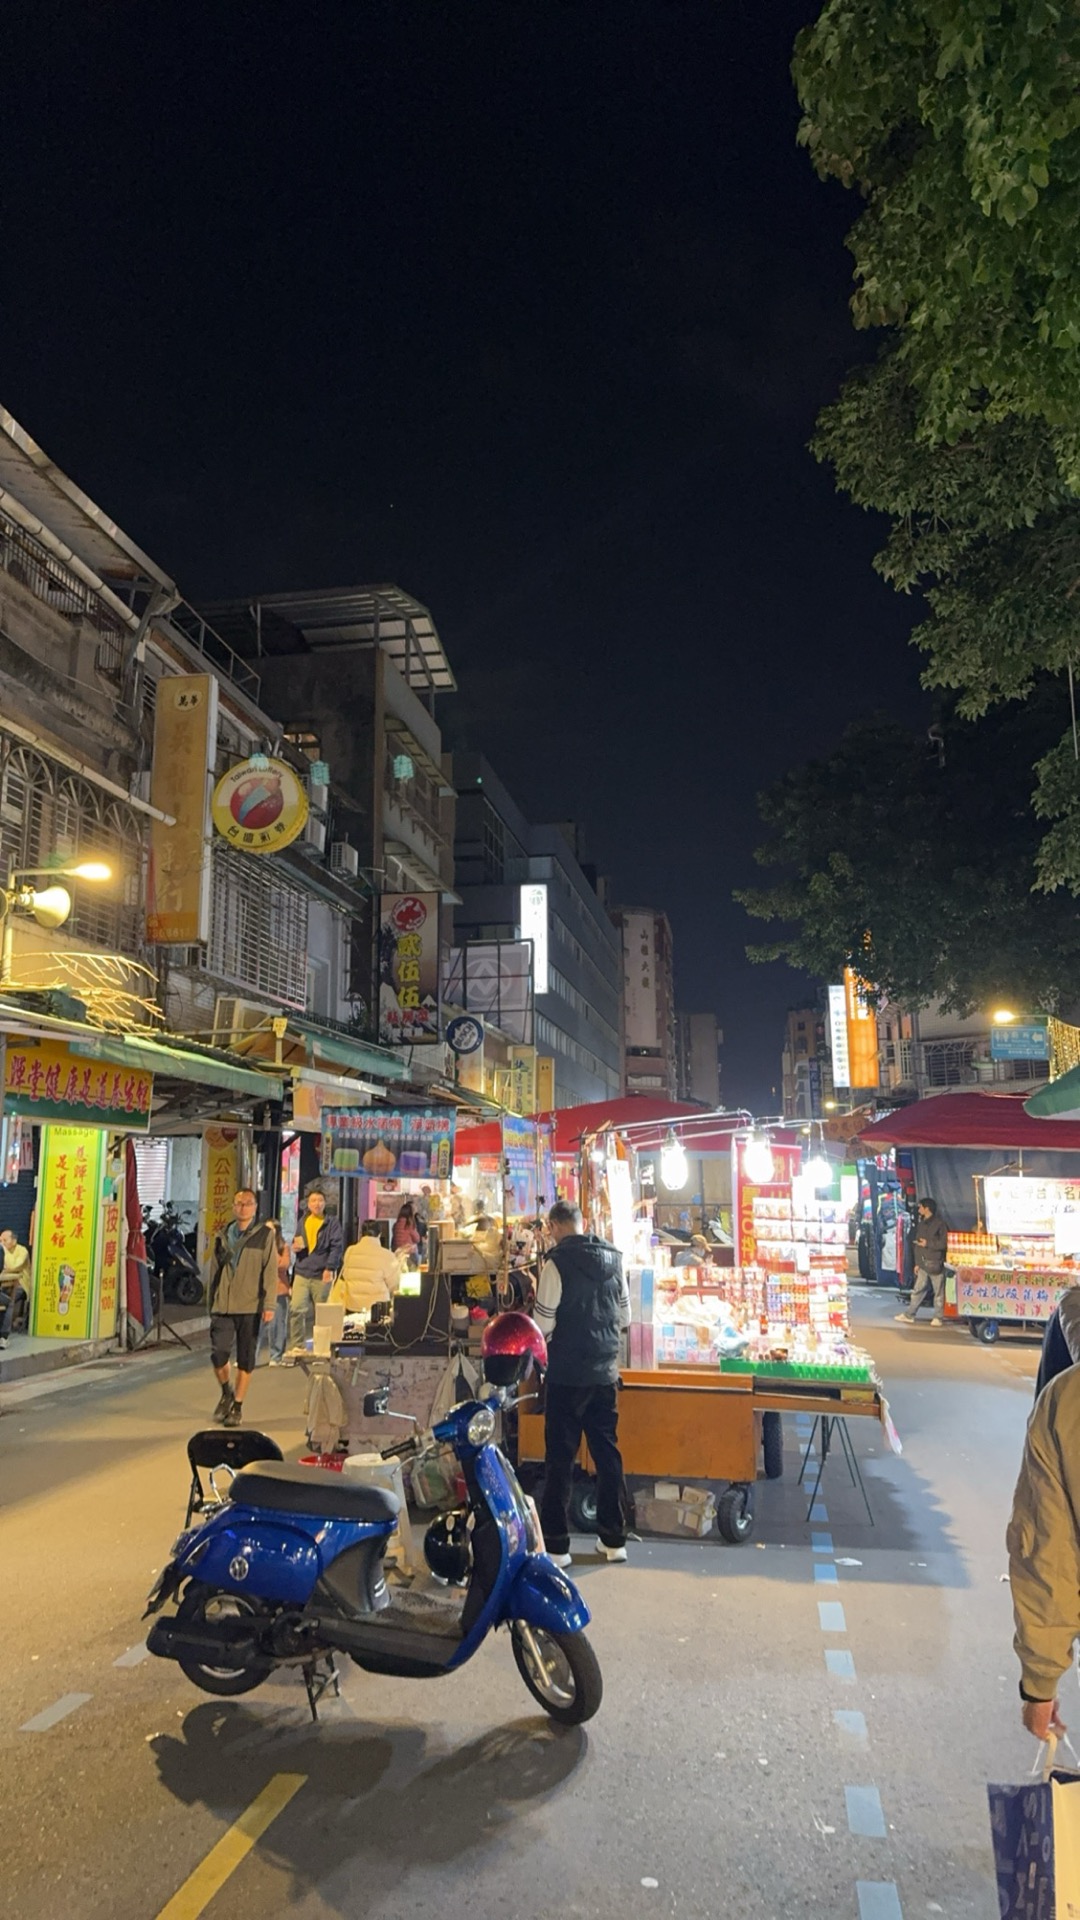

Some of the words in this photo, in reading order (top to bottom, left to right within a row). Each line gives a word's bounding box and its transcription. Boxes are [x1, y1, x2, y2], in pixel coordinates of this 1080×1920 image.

[231, 767, 257, 783] Taiwan
[397, 933, 422, 1009] 貳伍伍
[5, 1055, 149, 1114] 輝堂健康足道養生館
[54, 1127, 95, 1137] Massage
[105, 1205, 118, 1267] 按摩
[962, 1285, 1048, 1301] 活性乳酸菌梅
